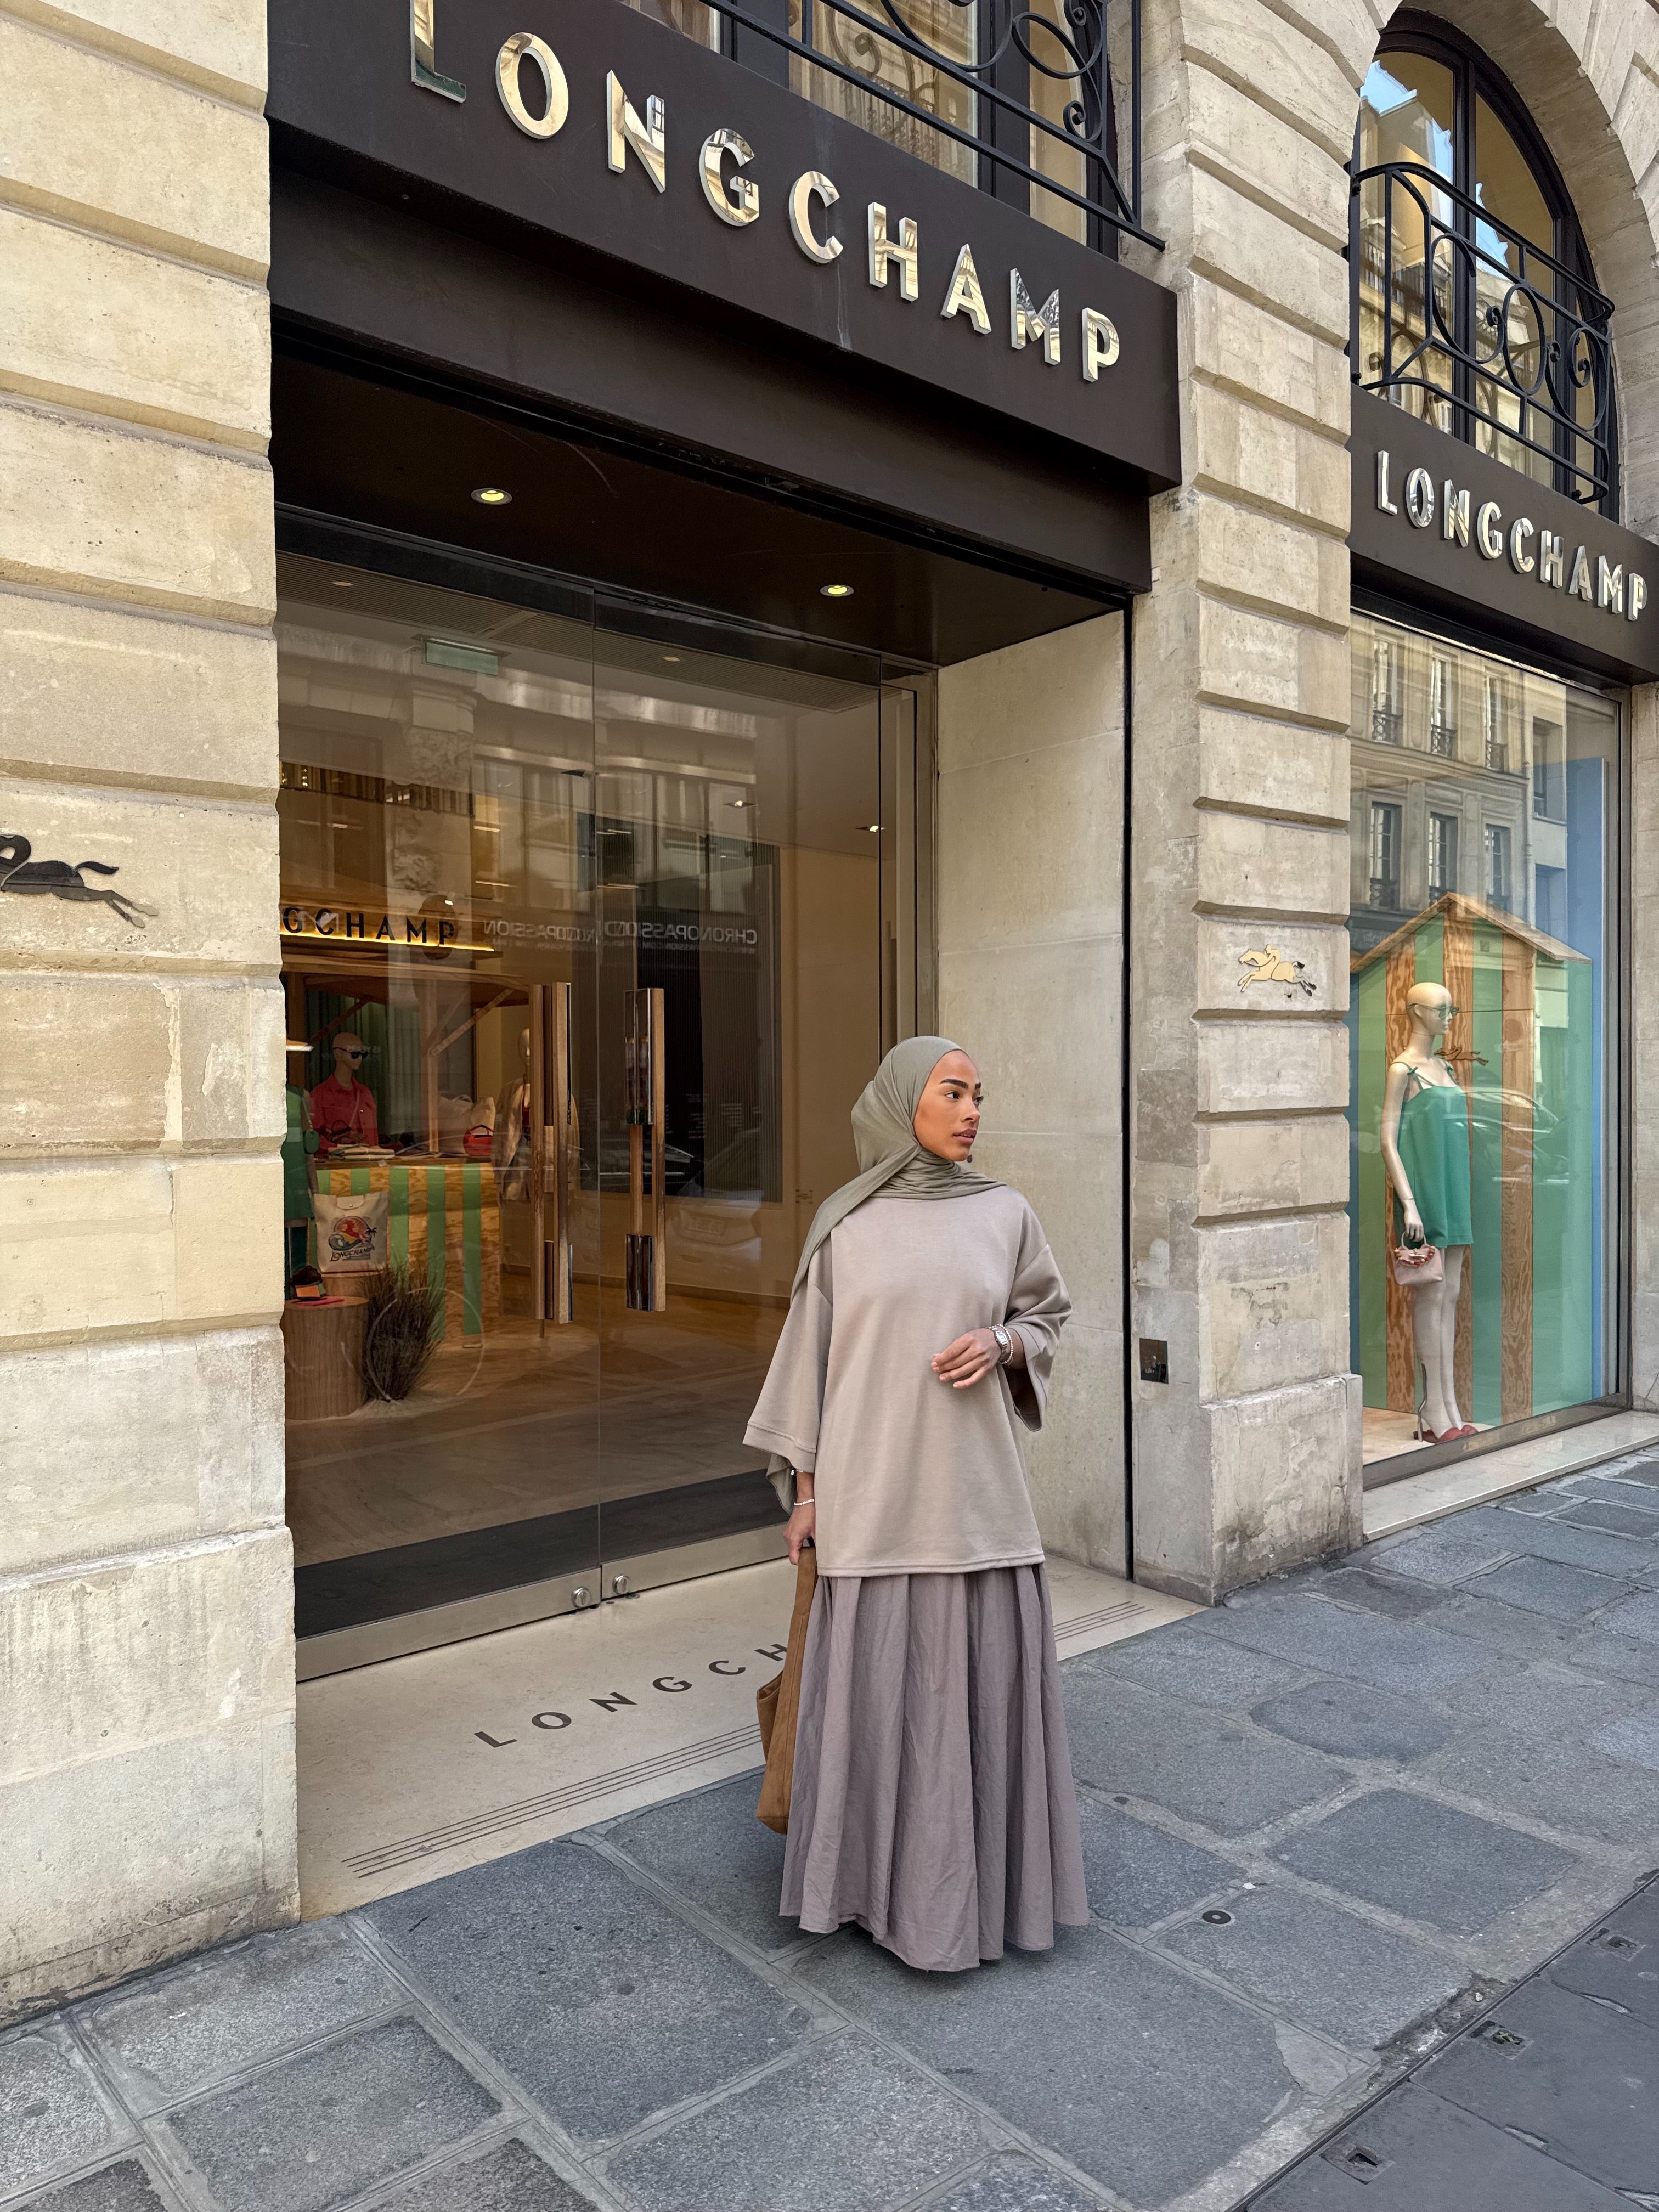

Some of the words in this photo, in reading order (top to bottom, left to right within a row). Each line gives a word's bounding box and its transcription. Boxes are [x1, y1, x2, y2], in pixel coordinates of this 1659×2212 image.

[410, 0, 1120, 382] LONGCHAMP
[1378, 450, 1647, 621] LONGCHAMP
[283, 906, 455, 945] GCHAMP
[473, 1643, 788, 1748] LONGCH
